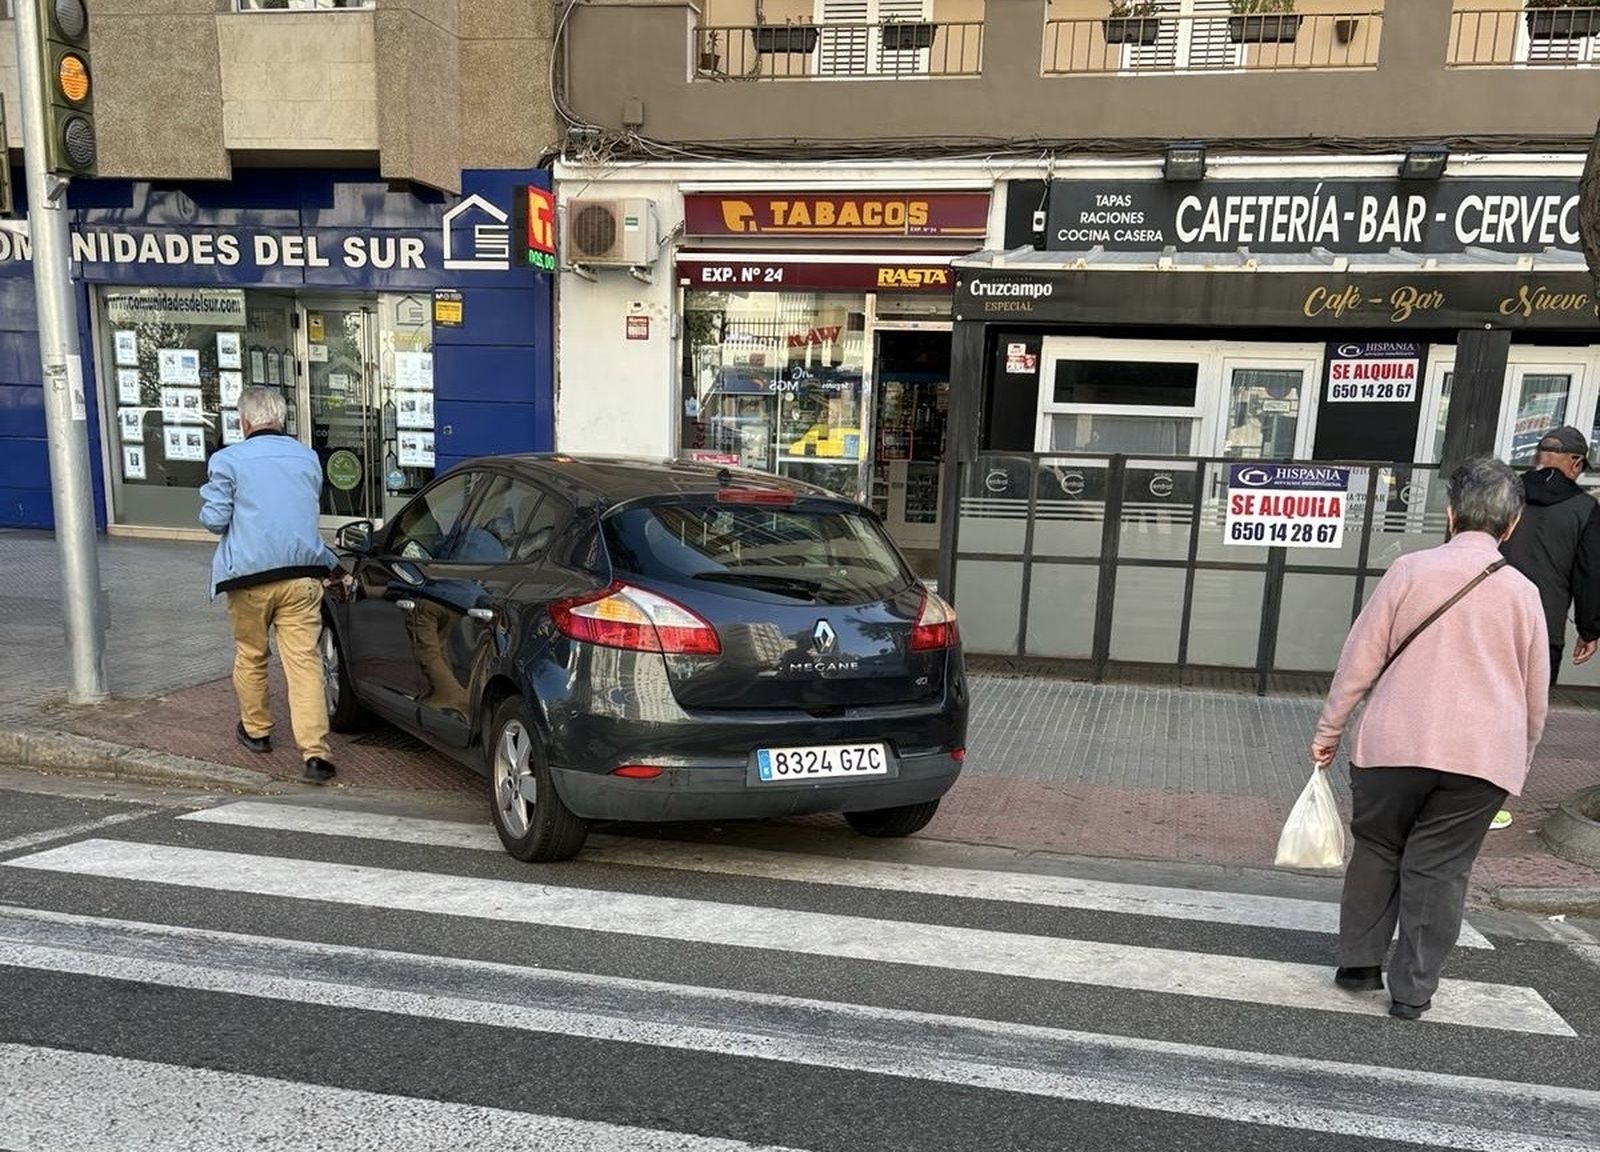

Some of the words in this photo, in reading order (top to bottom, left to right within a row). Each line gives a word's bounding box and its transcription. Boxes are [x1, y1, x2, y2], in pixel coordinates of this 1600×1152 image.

[1096, 194, 1131, 207] TAPAS
[770, 201, 928, 226] TABACOS
[1080, 212, 1144, 225] RACIONES
[1057, 229, 1110, 242] COCINA
[1114, 229, 1163, 243] CASERA
[254, 235, 330, 267] DEL
[343, 236, 427, 269] SUR
[702, 267, 737, 282] EXP.
[764, 268, 783, 282] 24
[878, 268, 947, 284] RASTA
[970, 279, 1053, 298] Cruzcampo
[984, 301, 1033, 312] ESPECIAL
[1304, 285, 1362, 318] Café
[1390, 286, 1445, 322] Bar
[1499, 285, 1590, 317] Nuevo
[1366, 343, 1415, 351] HISPANIA
[1332, 364, 1350, 379] SE
[1354, 363, 1415, 381] ALQUILA
[1332, 384, 1357, 398] 650
[1361, 384, 1374, 398] 14
[1377, 384, 1394, 398] 28
[1396, 383, 1411, 398] 67
[1276, 468, 1340, 480] HISPANIA
[1231, 494, 1256, 515] SE
[1258, 495, 1341, 519] ALQUILA
[1231, 522, 1265, 541] 650
[1269, 522, 1287, 541] 14
[1291, 523, 1313, 542] 28
[1317, 524, 1338, 543] 67
[790, 661, 859, 671] MEGANE
[776, 751, 833, 775] 8324
[840, 748, 881, 770] GZC
